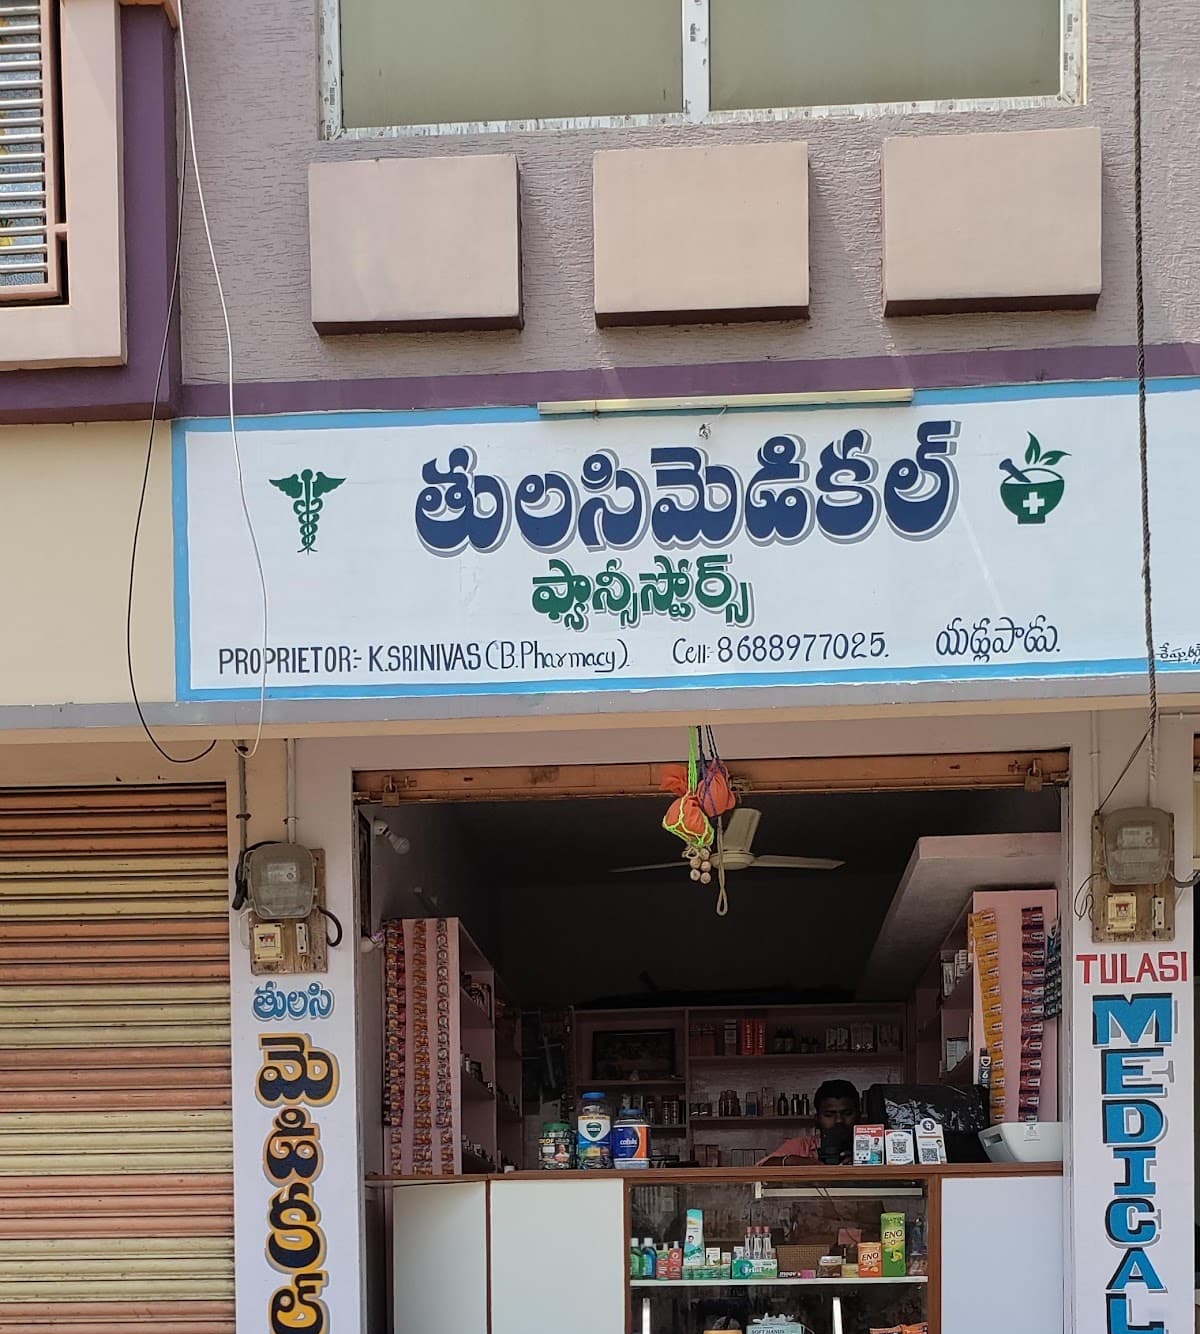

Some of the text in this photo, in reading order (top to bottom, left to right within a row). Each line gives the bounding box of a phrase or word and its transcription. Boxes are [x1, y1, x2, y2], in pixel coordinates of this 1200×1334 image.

[1076, 951, 1188, 985] TULASI
[253, 980, 335, 1021] తులసి
[885, 1230, 902, 1239] ENO
[862, 1252, 879, 1261] ENO
